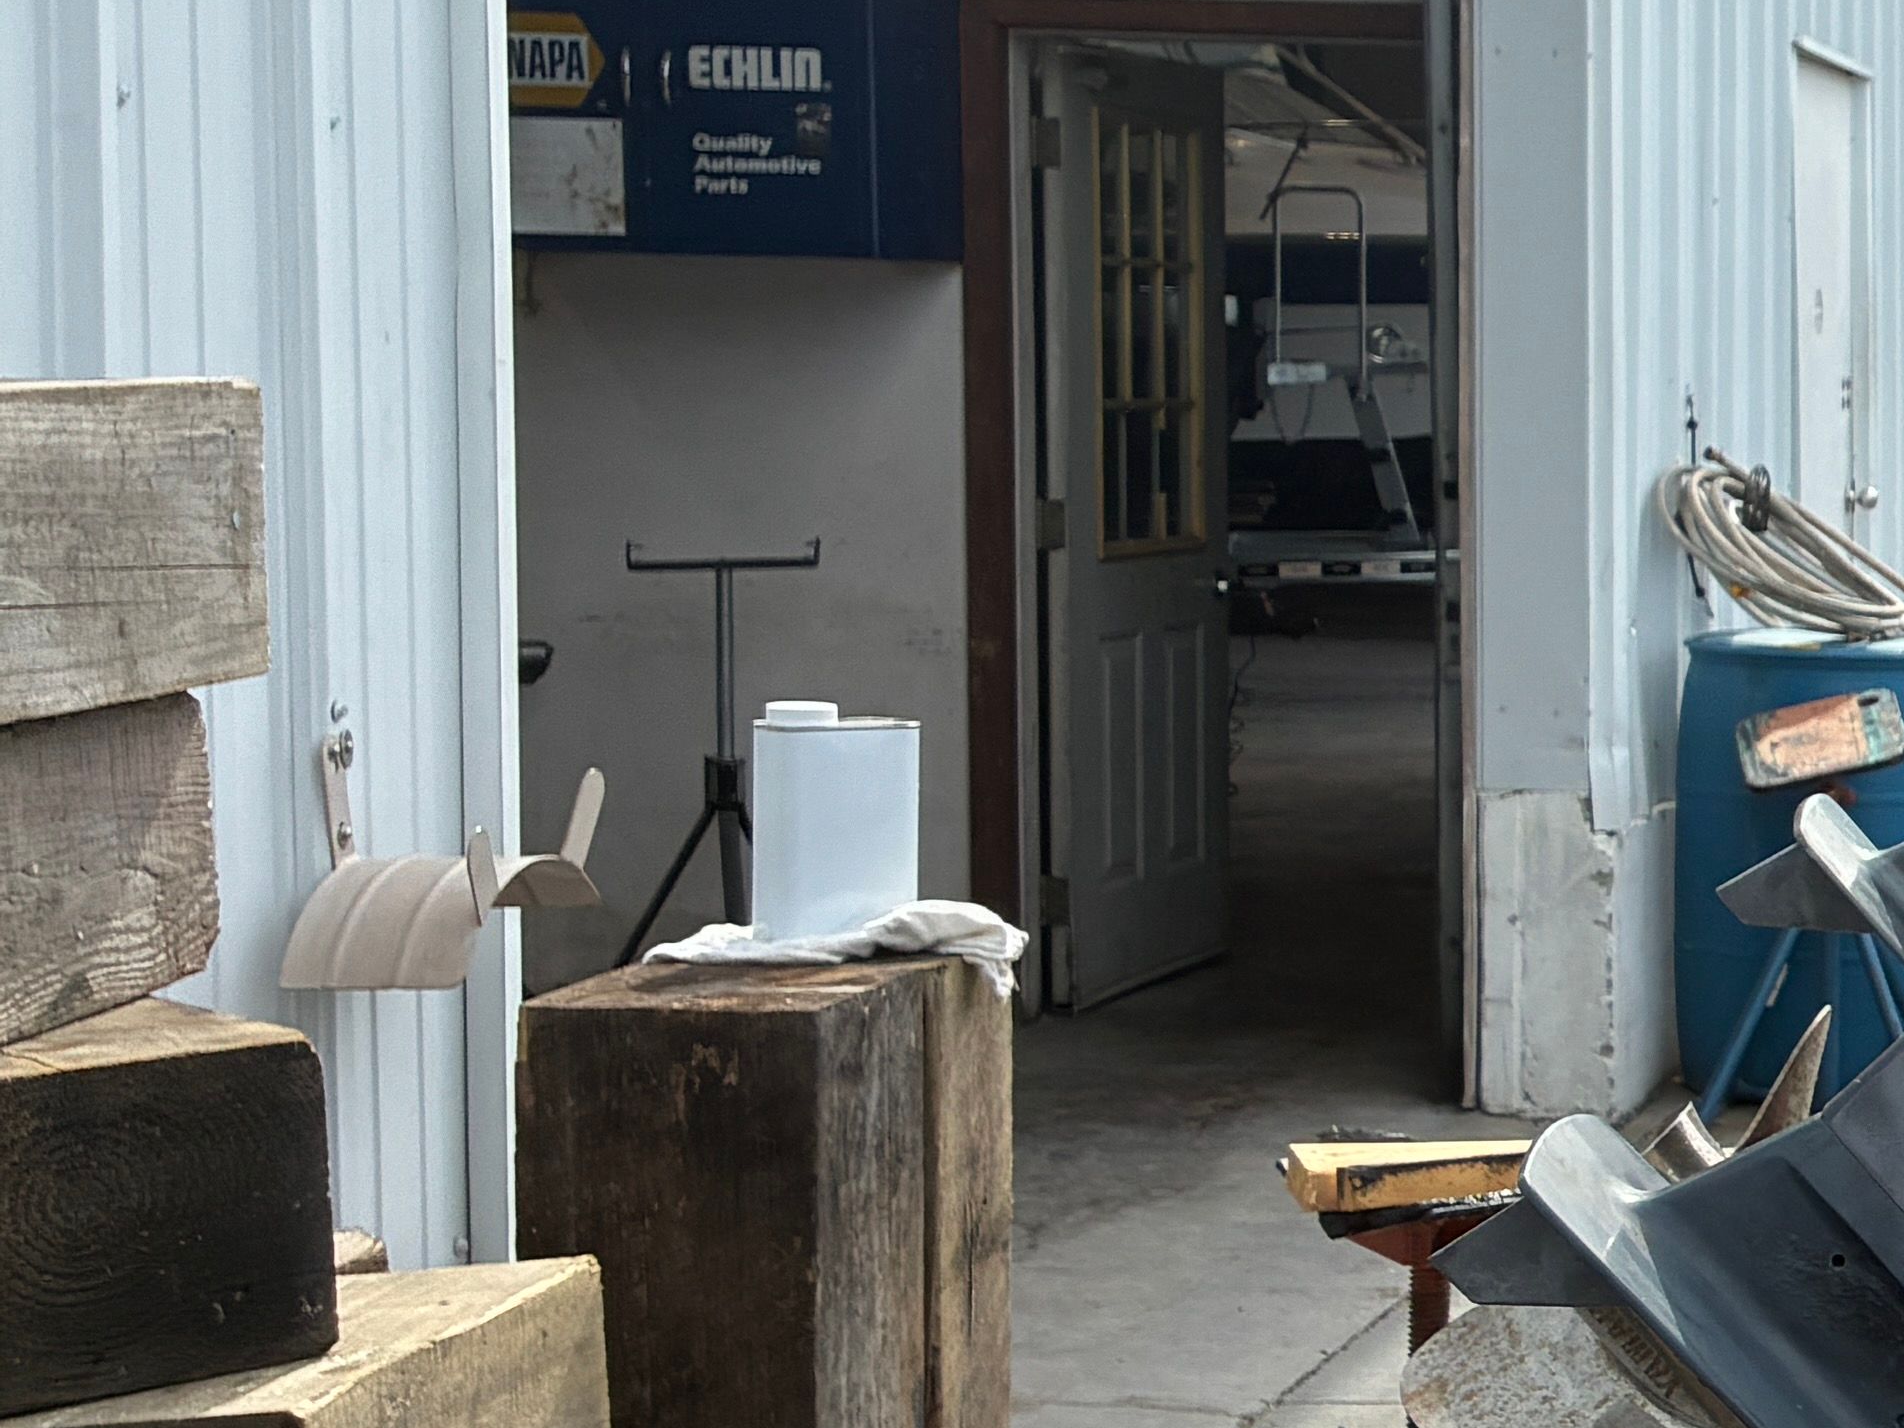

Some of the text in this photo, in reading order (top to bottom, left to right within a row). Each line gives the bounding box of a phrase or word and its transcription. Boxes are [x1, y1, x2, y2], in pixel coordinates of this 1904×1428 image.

[508, 38, 585, 80] NAPA
[688, 45, 822, 92] ECHLIN
[692, 132, 773, 156] Quality
[694, 154, 822, 175] Automotive
[694, 175, 749, 195] Parts
[1587, 1307, 1681, 1399] YAMAH
